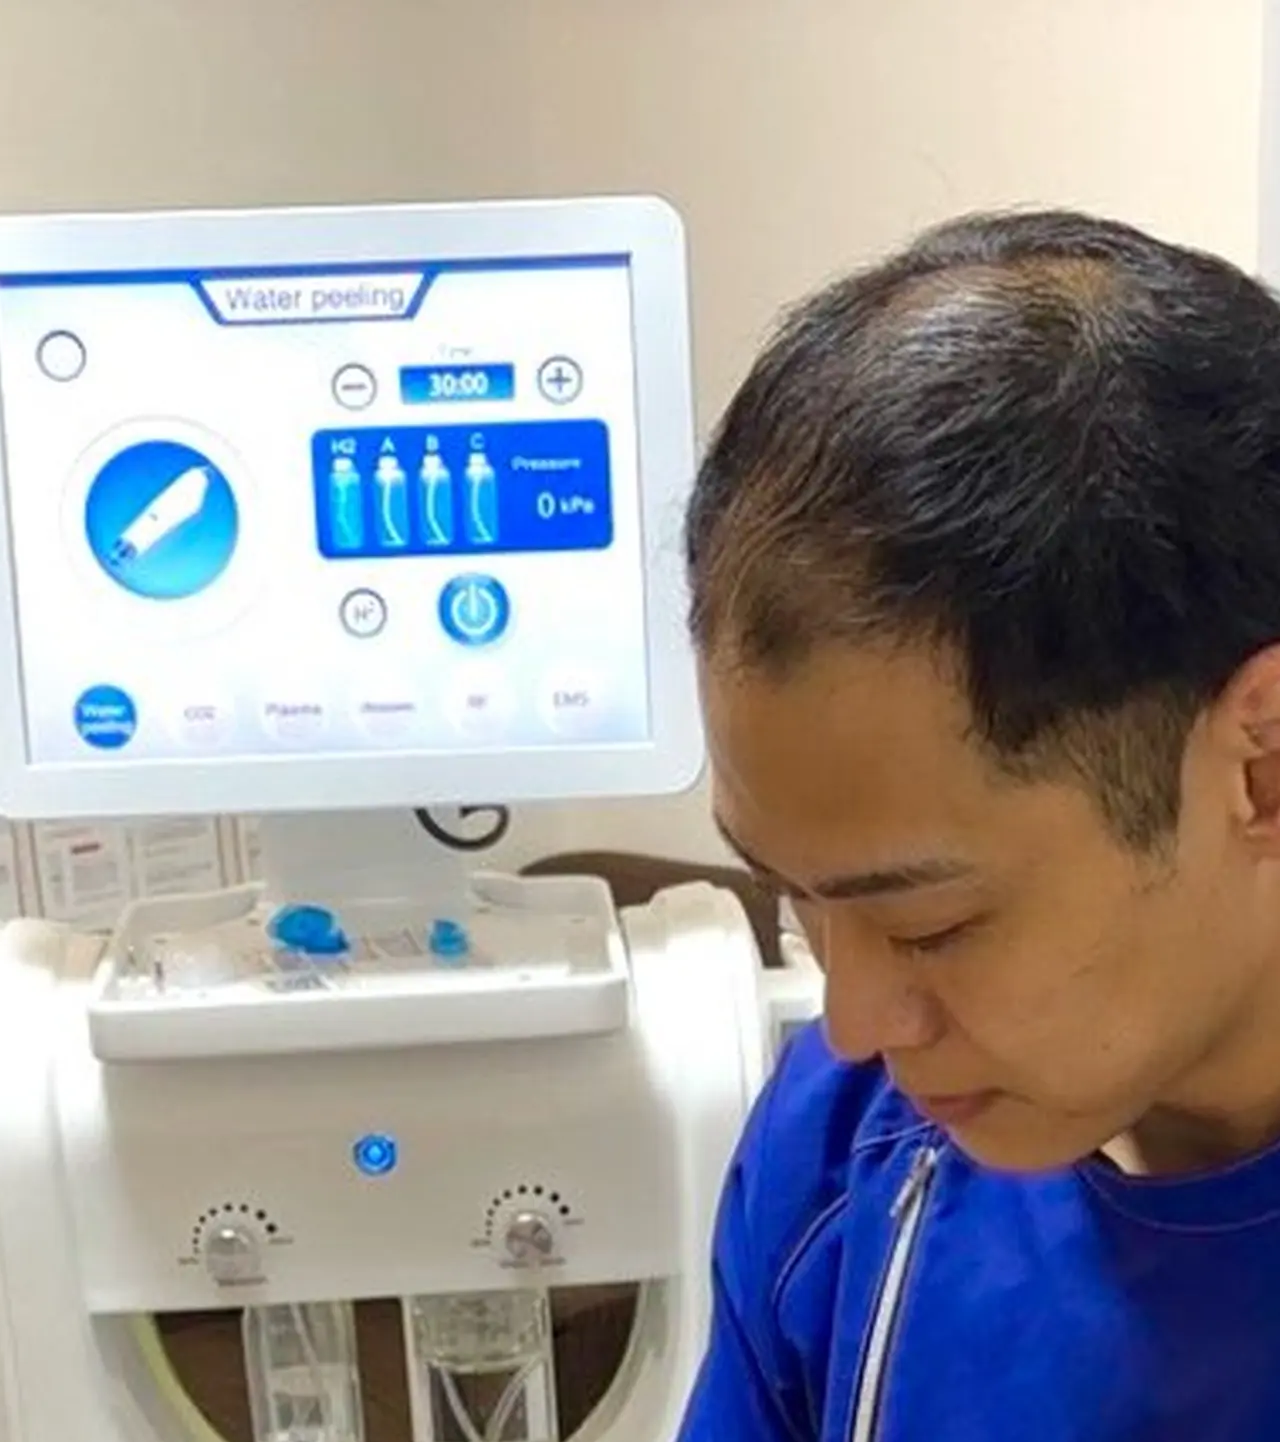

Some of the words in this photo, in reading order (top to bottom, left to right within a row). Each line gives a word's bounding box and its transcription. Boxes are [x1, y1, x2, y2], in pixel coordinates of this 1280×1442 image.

[226, 287, 302, 311] Water
[312, 283, 405, 313] peeling
[427, 372, 489, 398] 30:00
[380, 436, 395, 452] A
[425, 435, 439, 451] B
[469, 433, 485, 450] C
[535, 492, 556, 518] 0
